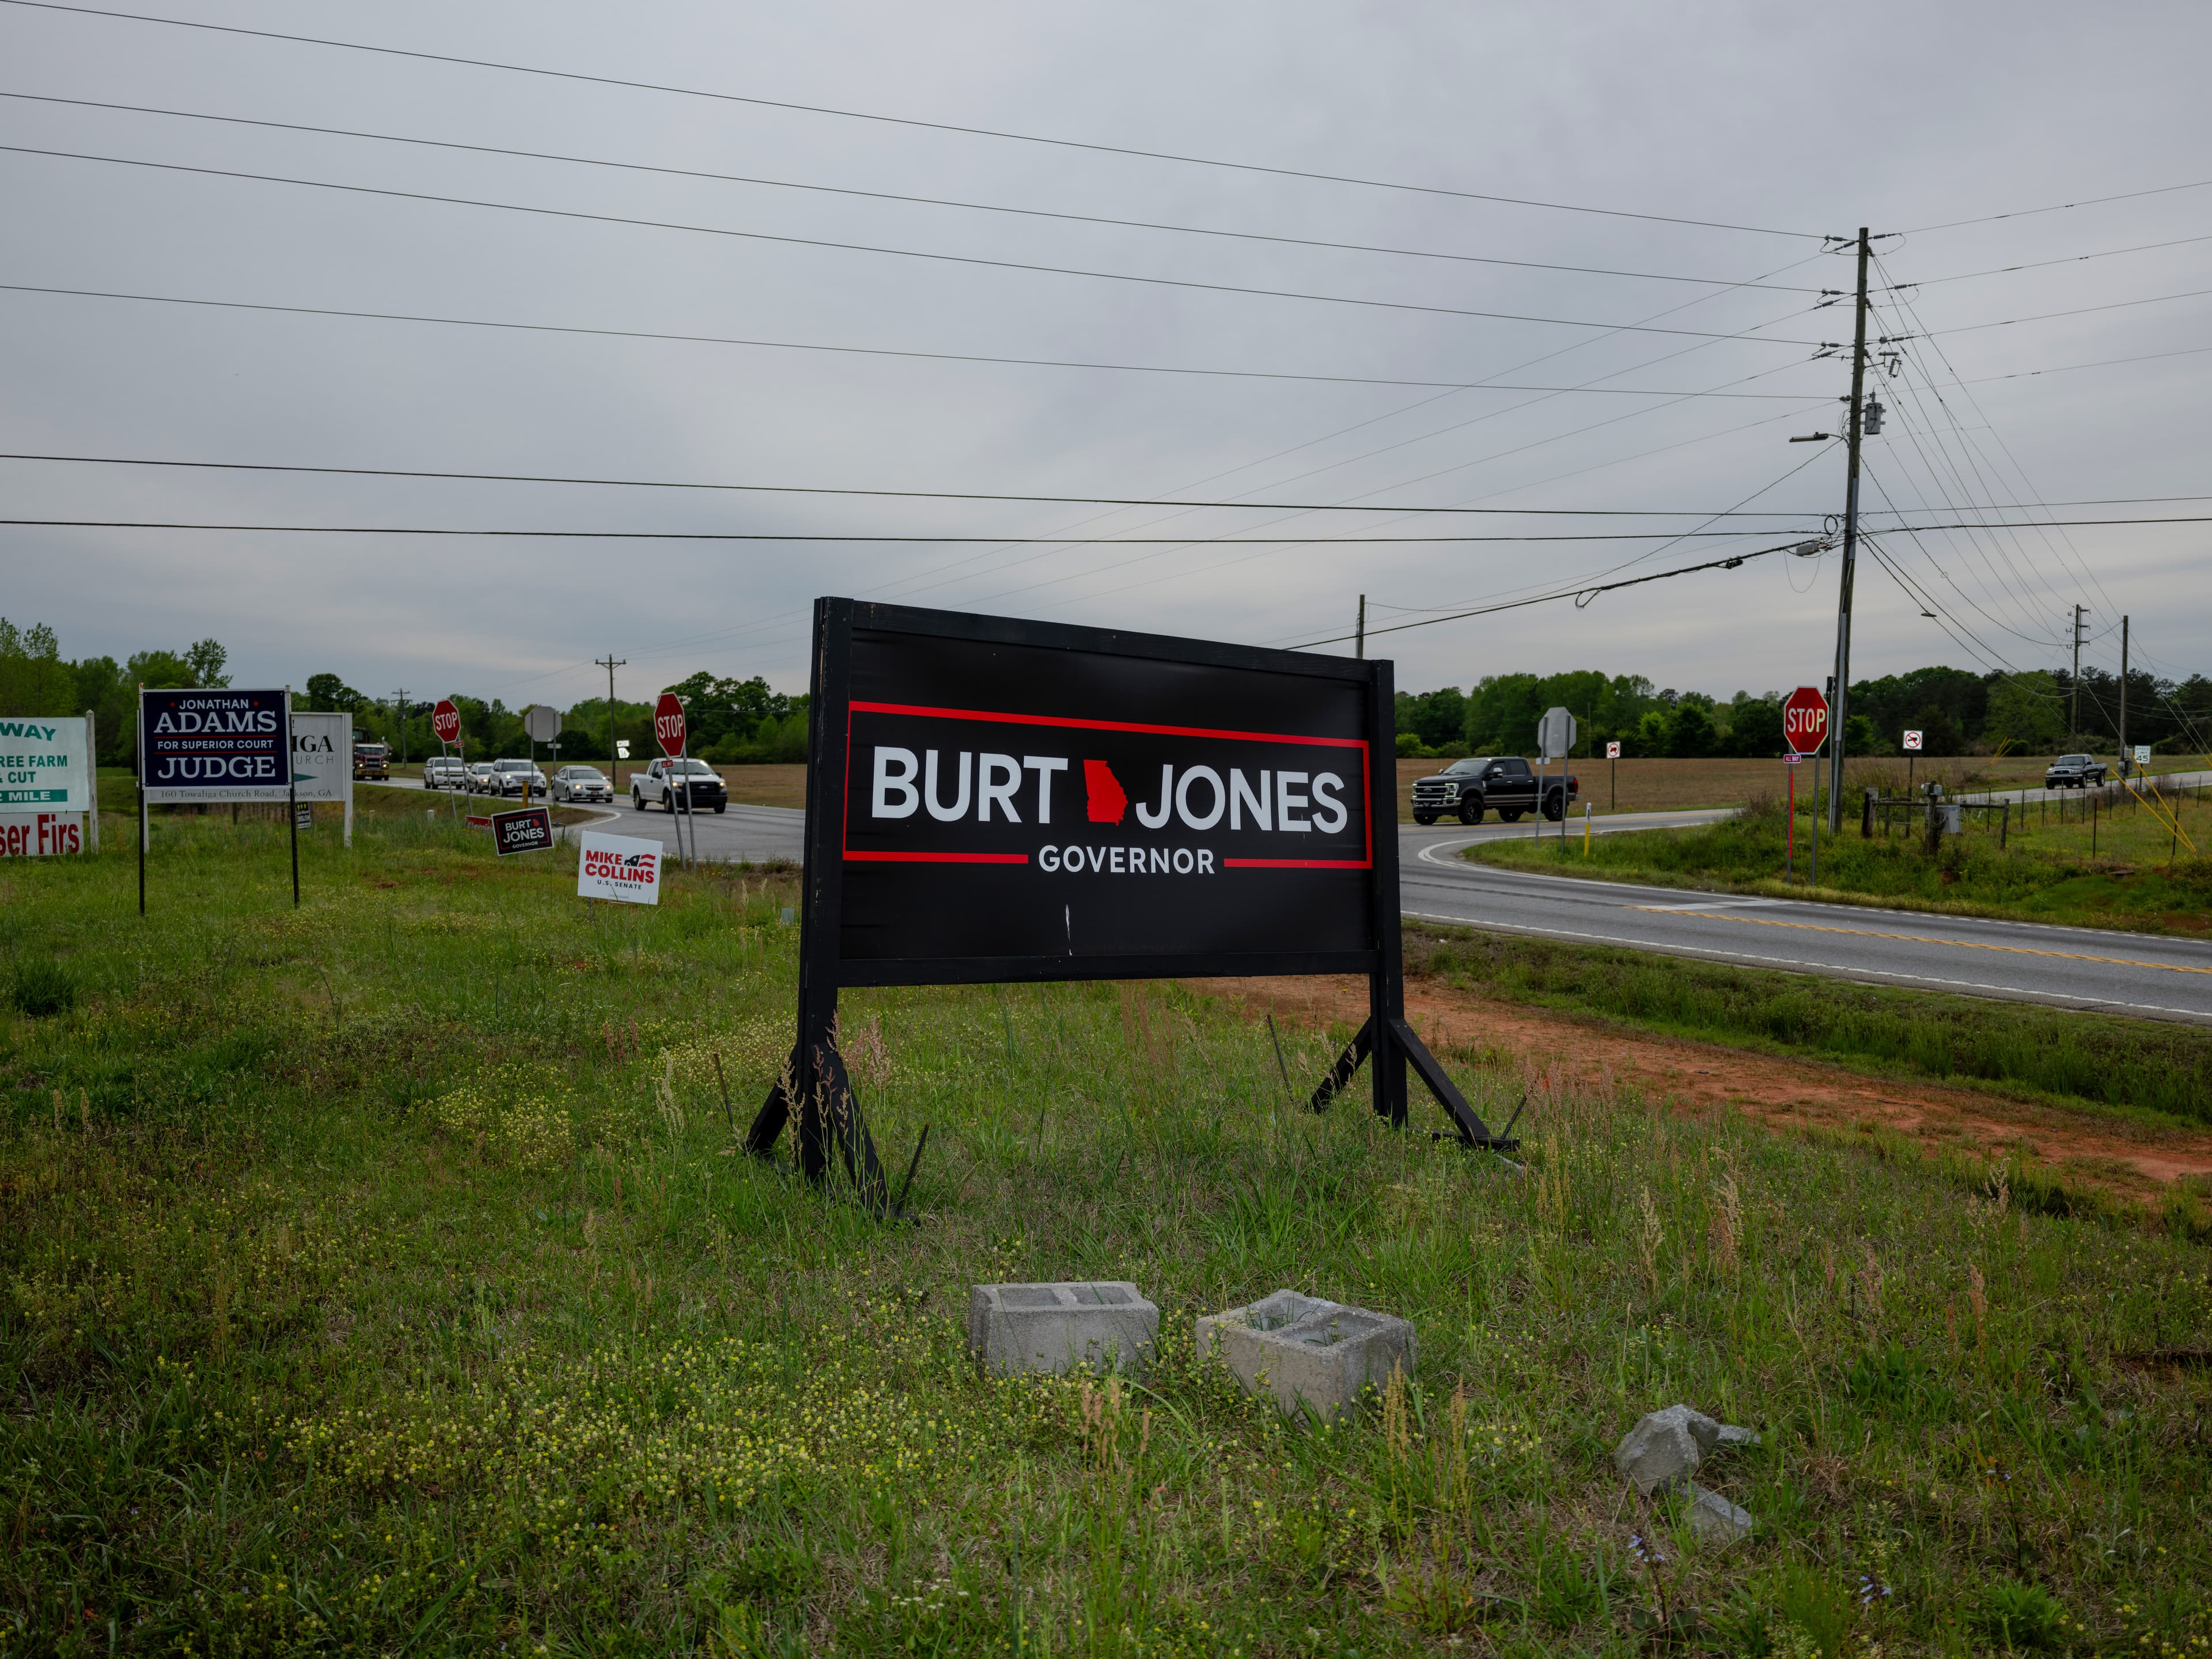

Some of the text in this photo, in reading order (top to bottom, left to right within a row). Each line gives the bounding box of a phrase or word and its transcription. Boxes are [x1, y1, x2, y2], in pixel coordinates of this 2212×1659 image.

[179, 699, 249, 710] JONATHAN
[153, 710, 277, 733] ADAMS
[435, 711, 457, 731] STOP
[657, 714, 683, 739] STOP
[1787, 707, 1825, 733] STOP
[0, 722, 56, 741] WAY
[157, 740, 274, 749] FOR SUPERIOR COURT
[29, 755, 67, 767] FARM
[296, 755, 334, 764] URCH
[157, 756, 276, 779] JUDGE
[7, 771, 36, 783] CUT
[9, 791, 51, 801] MILE
[179, 790, 217, 799] Towaliga
[219, 789, 251, 798] Church
[254, 789, 276, 798] Road,
[282, 789, 315, 797] Jakson,
[872, 746, 1347, 834] BURT JONES
[505, 819, 531, 832] BURT
[37, 813, 79, 855] Firs
[503, 827, 544, 843] JONES
[512, 841, 539, 849] GOVERNOR
[585, 850, 623, 865] MIKE
[1039, 844, 1215, 874] GOVERNOR
[585, 863, 655, 884] COLLINS
[615, 881, 642, 890] SENATE
